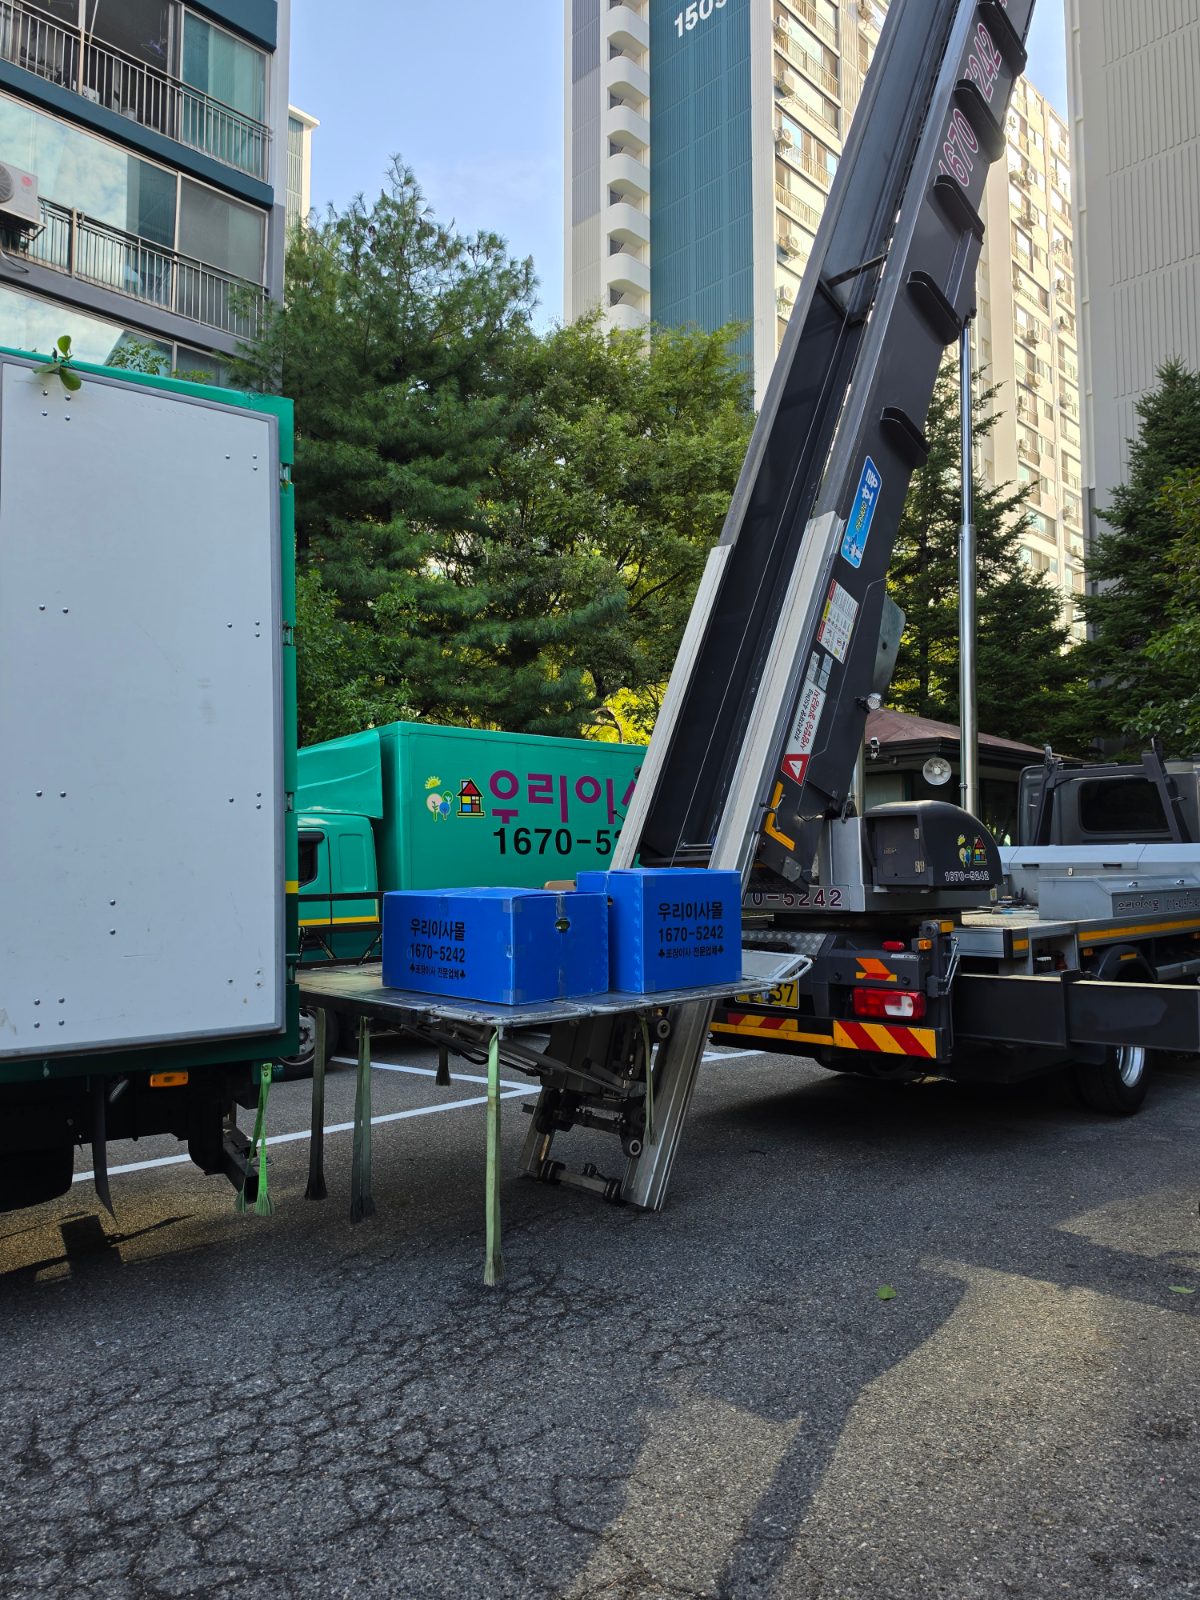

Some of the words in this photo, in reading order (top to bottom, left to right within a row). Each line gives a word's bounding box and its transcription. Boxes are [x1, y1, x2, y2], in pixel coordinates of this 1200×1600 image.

[944, 870, 990, 882] 1670-5242
[657, 901, 723, 921] 우리이사몰
[1118, 898, 1159, 913] 우리이사몰
[410, 918, 465, 942] 우리이사몰
[659, 926, 724, 943] 1670-5242
[410, 943, 465, 963] 1670-5242
